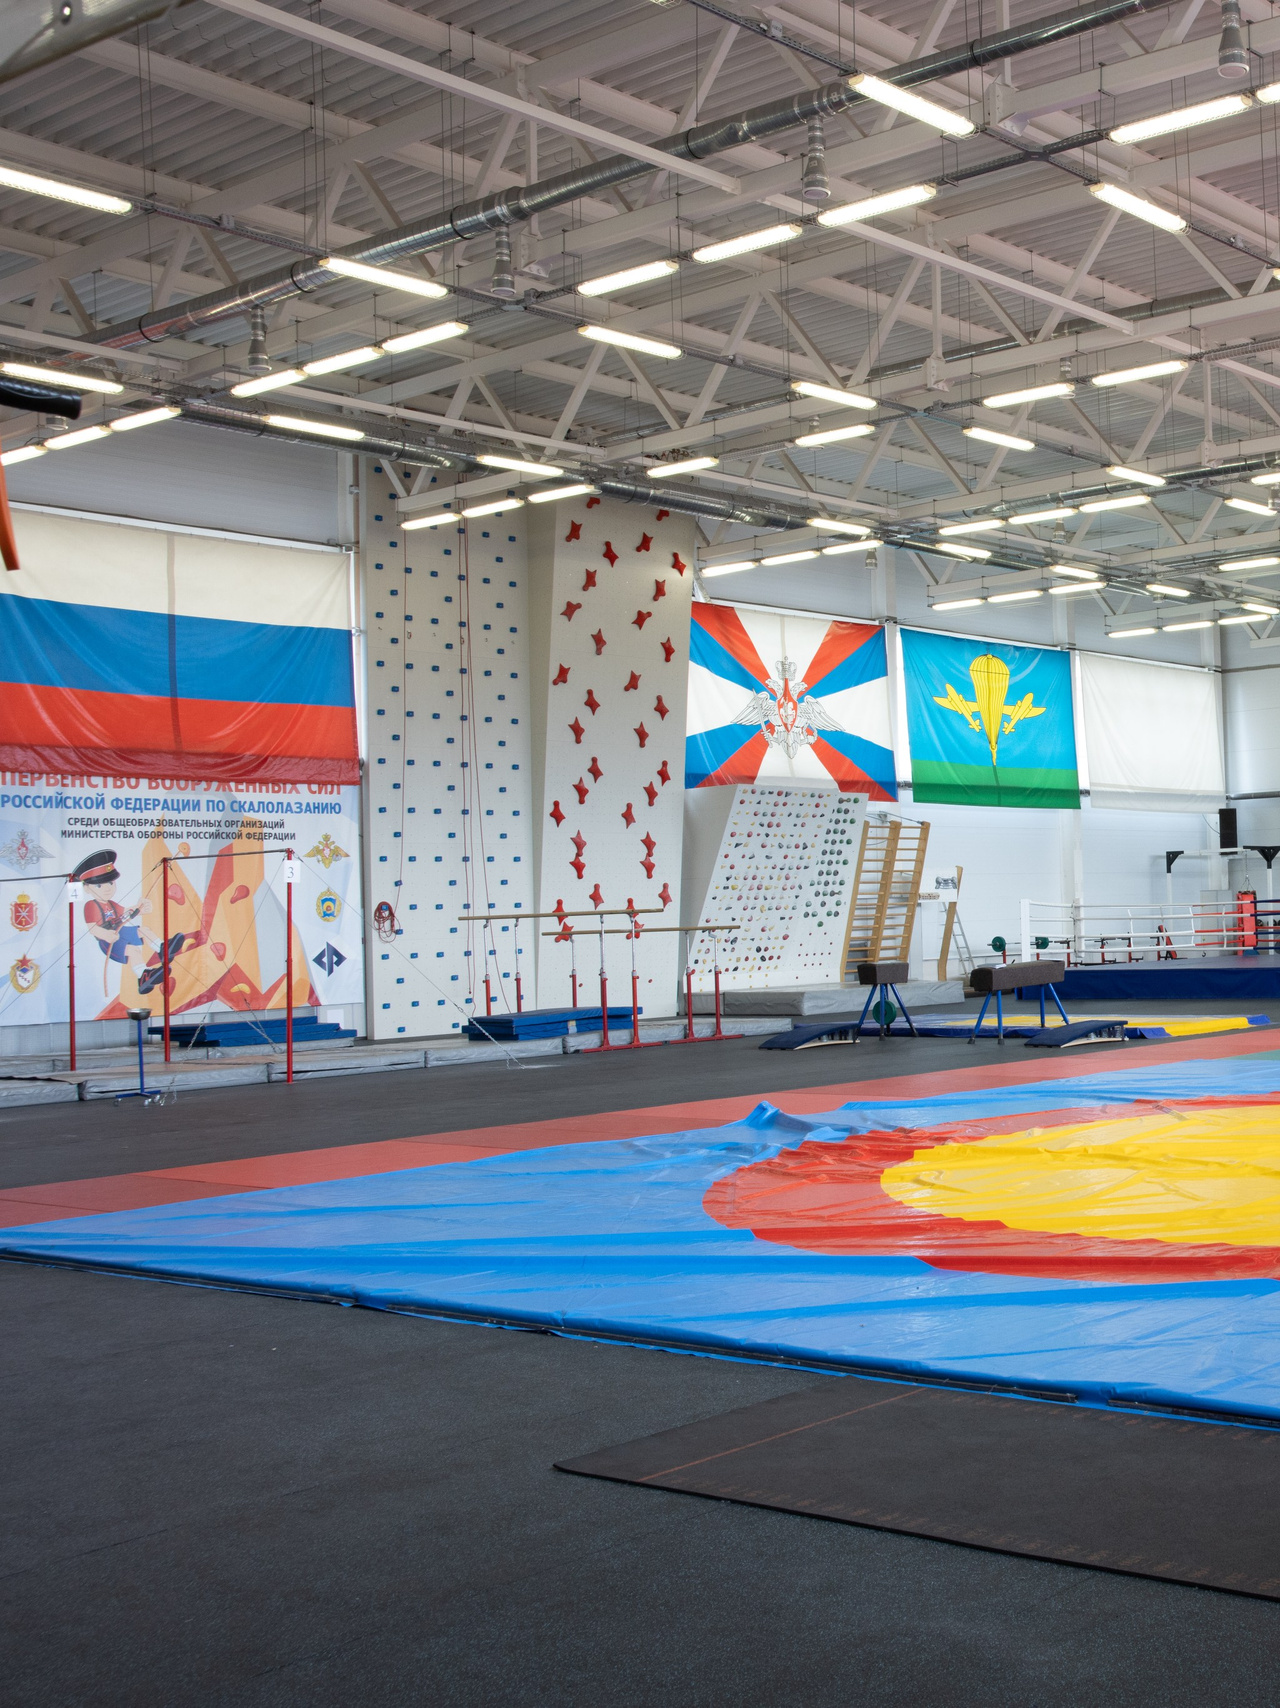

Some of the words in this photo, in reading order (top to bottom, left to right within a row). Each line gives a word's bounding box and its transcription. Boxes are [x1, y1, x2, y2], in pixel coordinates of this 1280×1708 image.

[1, 791, 105, 809] РОССИЙСКОЙ
[110, 797, 201, 814] ФЕДЕРАЦИИ
[206, 799, 226, 812] ПО
[229, 800, 342, 815] СКАЛОЛАЗАНИЮ
[67, 817, 100, 828] СРЕДИ
[102, 817, 222, 828] ОБЩЕОБРАЗОВАТЕЛЬНЫХ
[224, 818, 285, 830] ОРГАНИЗАЦИЙ
[61, 829, 135, 839] МИНИСТЕРСТВА
[137, 830, 184, 840] ОБОРОНЫ
[186, 829, 243, 840] РОССИЙСКОЙ
[245, 831, 296, 842] ФЕДЕРАЦИИ
[287, 866, 295, 879] 3
[70, 888, 79, 900] 4
